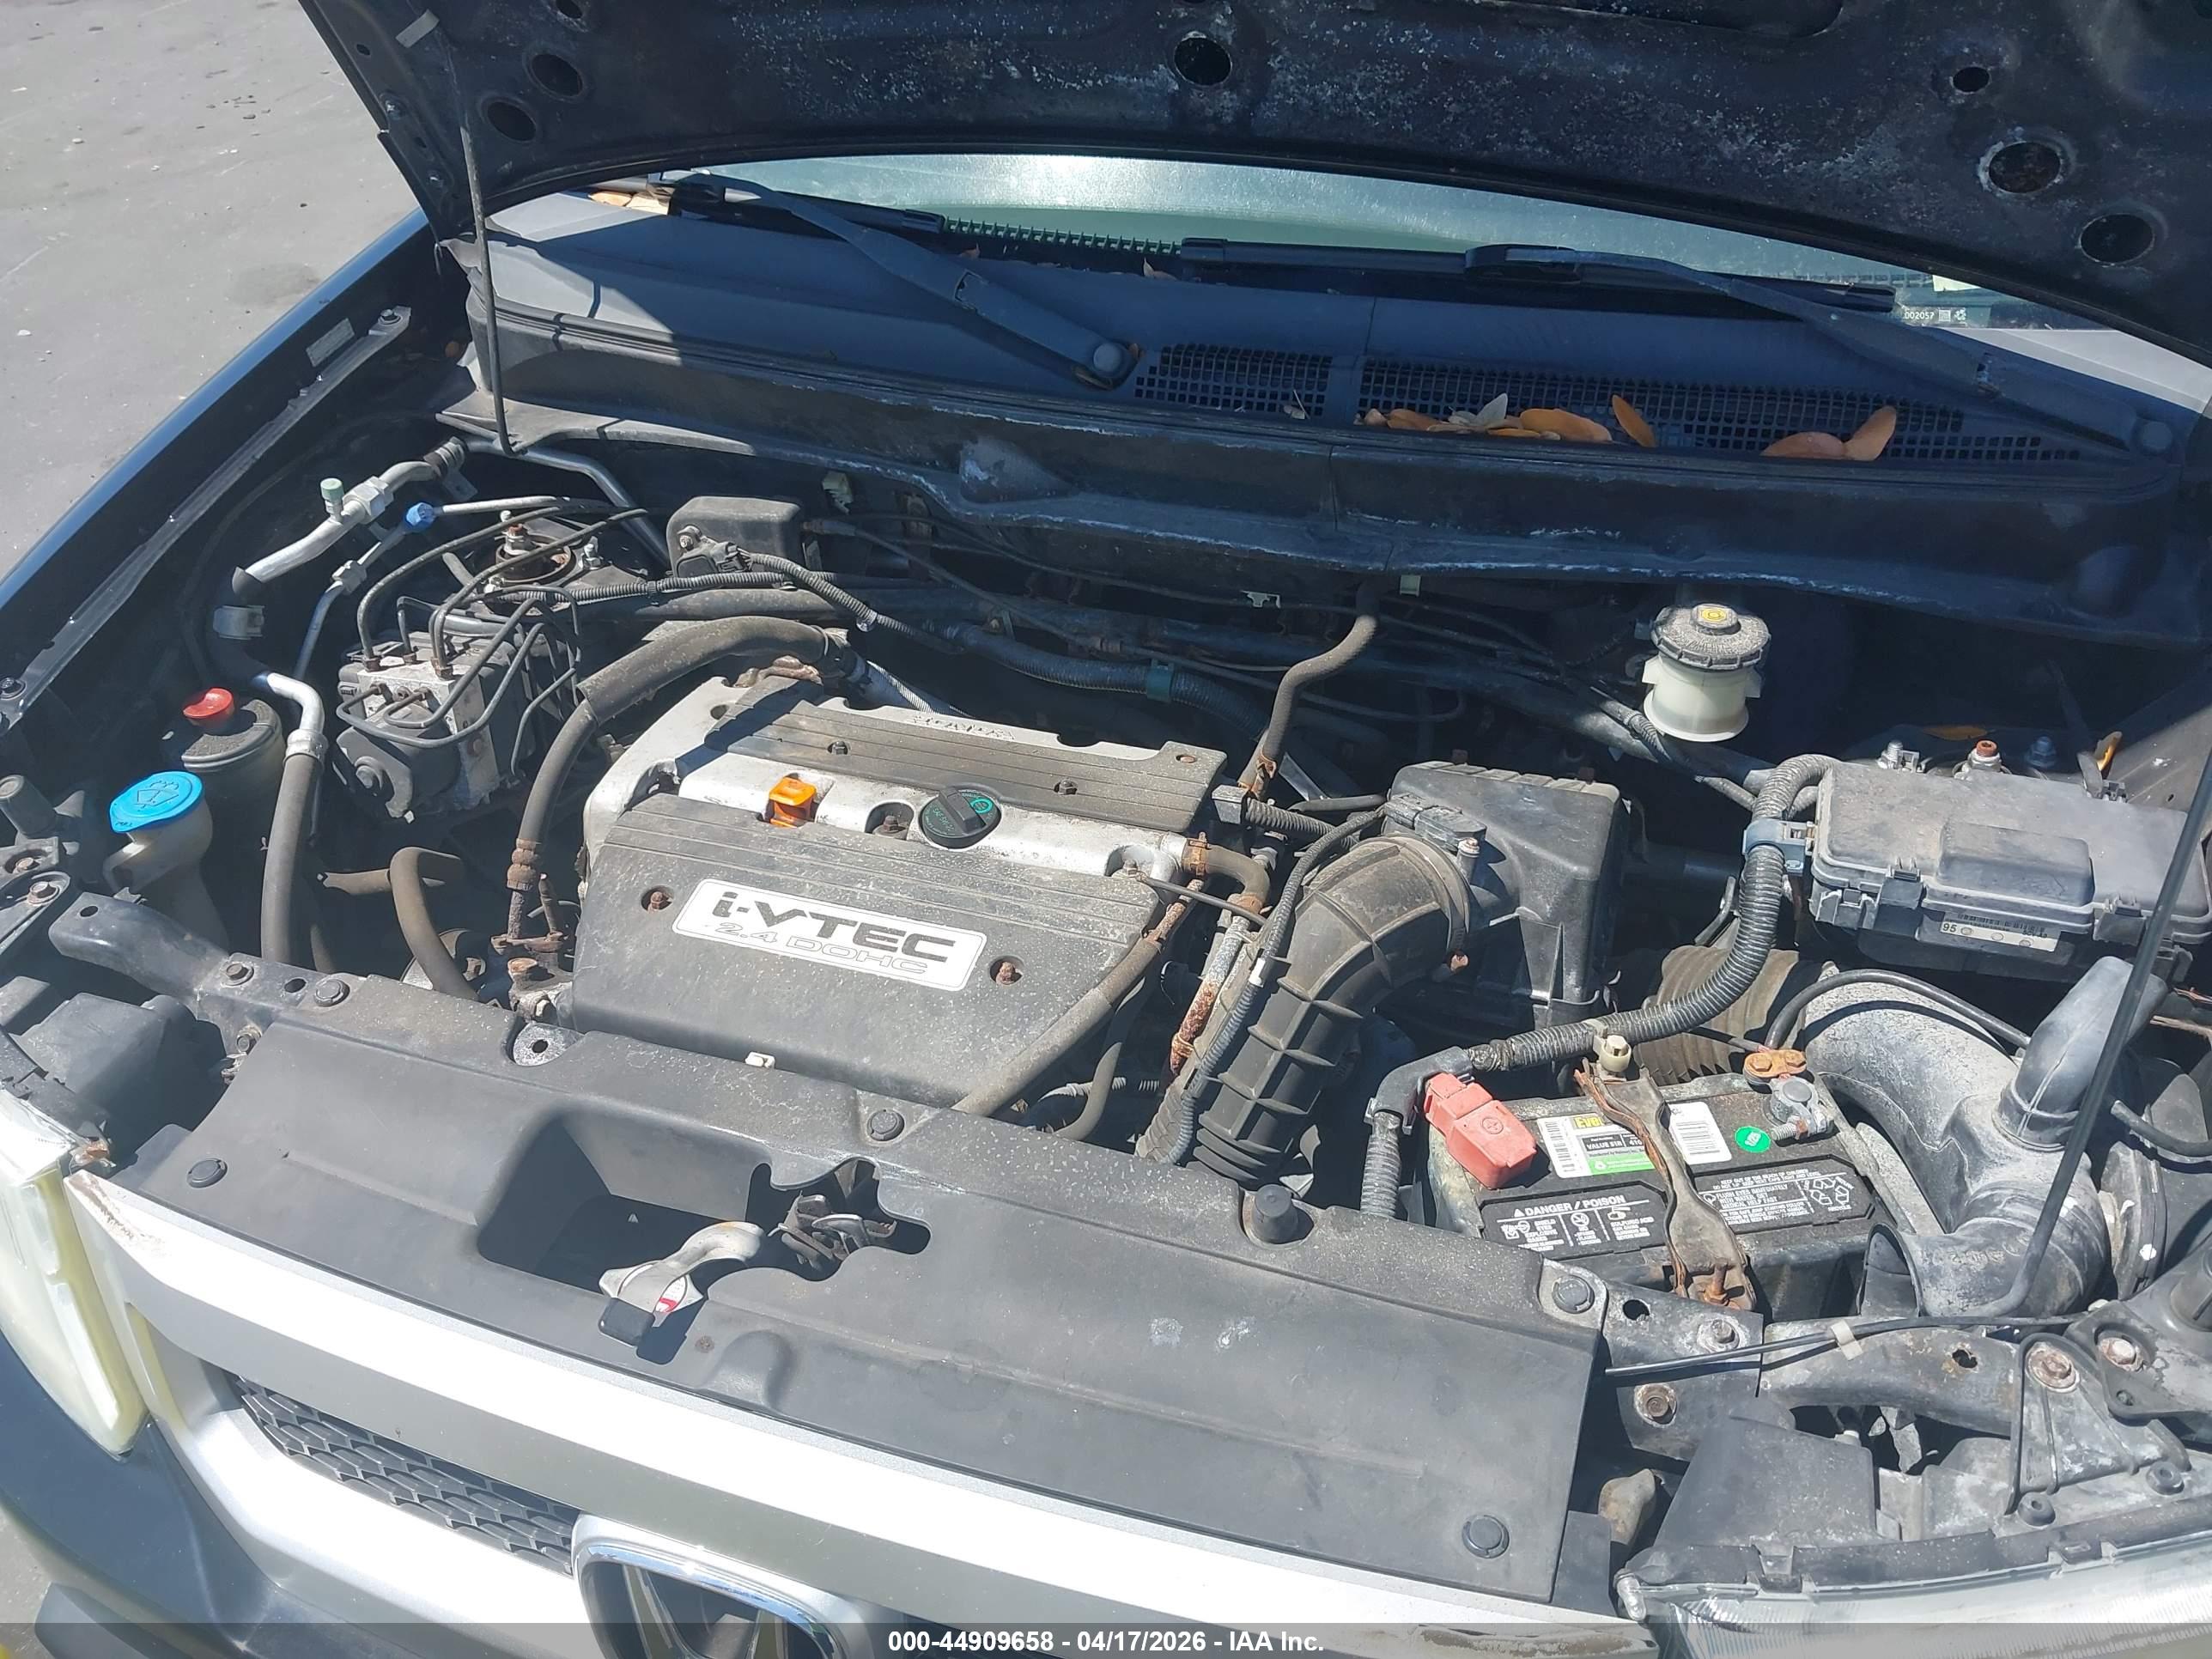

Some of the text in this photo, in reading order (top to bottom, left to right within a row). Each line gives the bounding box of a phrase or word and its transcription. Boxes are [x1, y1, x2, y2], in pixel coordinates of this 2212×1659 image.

[711, 891, 957, 963] i-VTEC
[1942, 922, 1958, 933] 95
[714, 922, 928, 974] 2.4 DOHC
[1586, 1140, 1610, 1151] VALUE
[1716, 1183, 1788, 1200] FLUSH EYES IMMEDIATELY
[1525, 1203, 1572, 1216] DANGER
[1582, 1194, 1627, 1209] POISON
